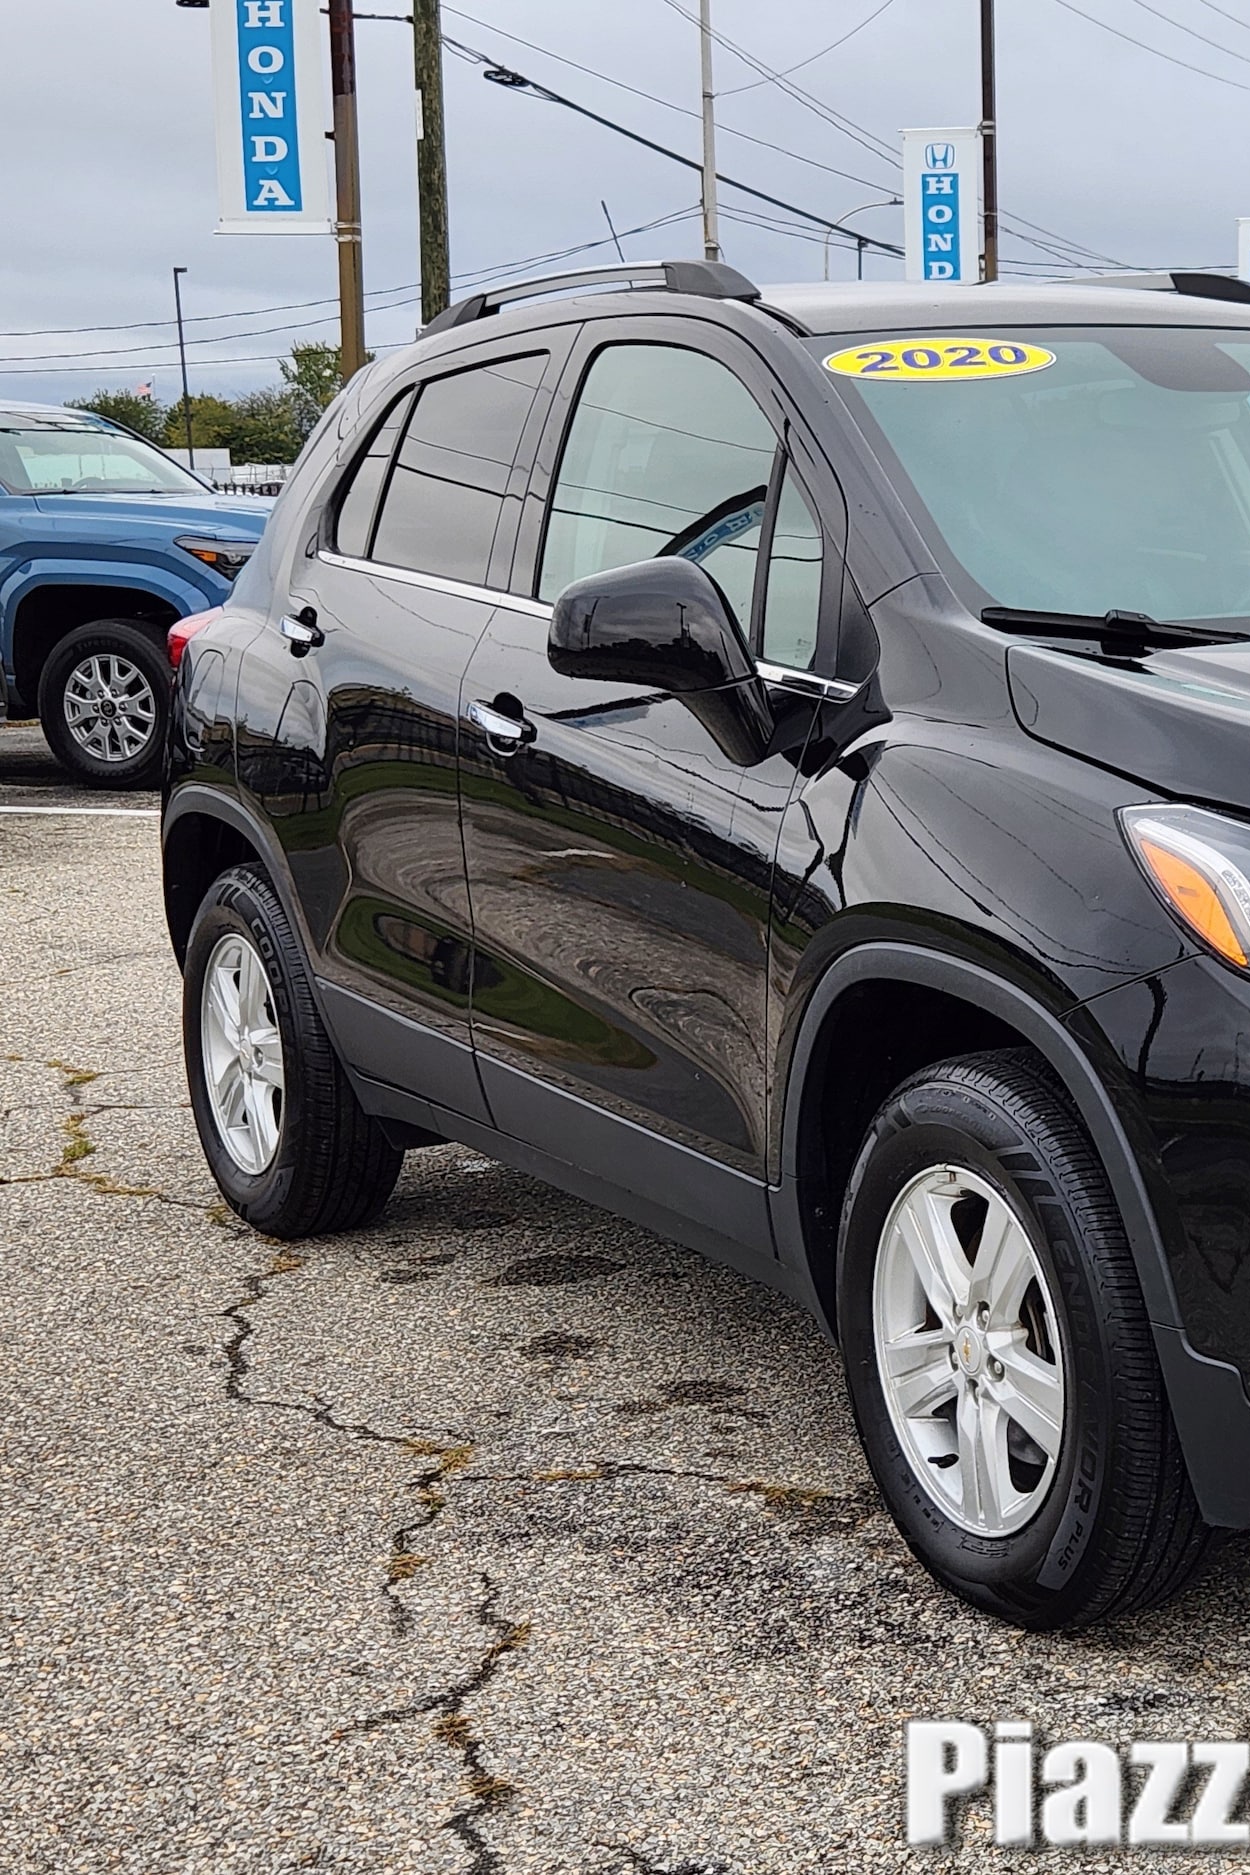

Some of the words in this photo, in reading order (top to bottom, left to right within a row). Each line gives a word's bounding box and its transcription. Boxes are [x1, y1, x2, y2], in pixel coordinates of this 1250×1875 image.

[244, 0, 295, 206] HONDA
[926, 176, 955, 280] HOND
[855, 344, 1030, 375] 2020
[1058, 1521, 1083, 1571] PLUS
